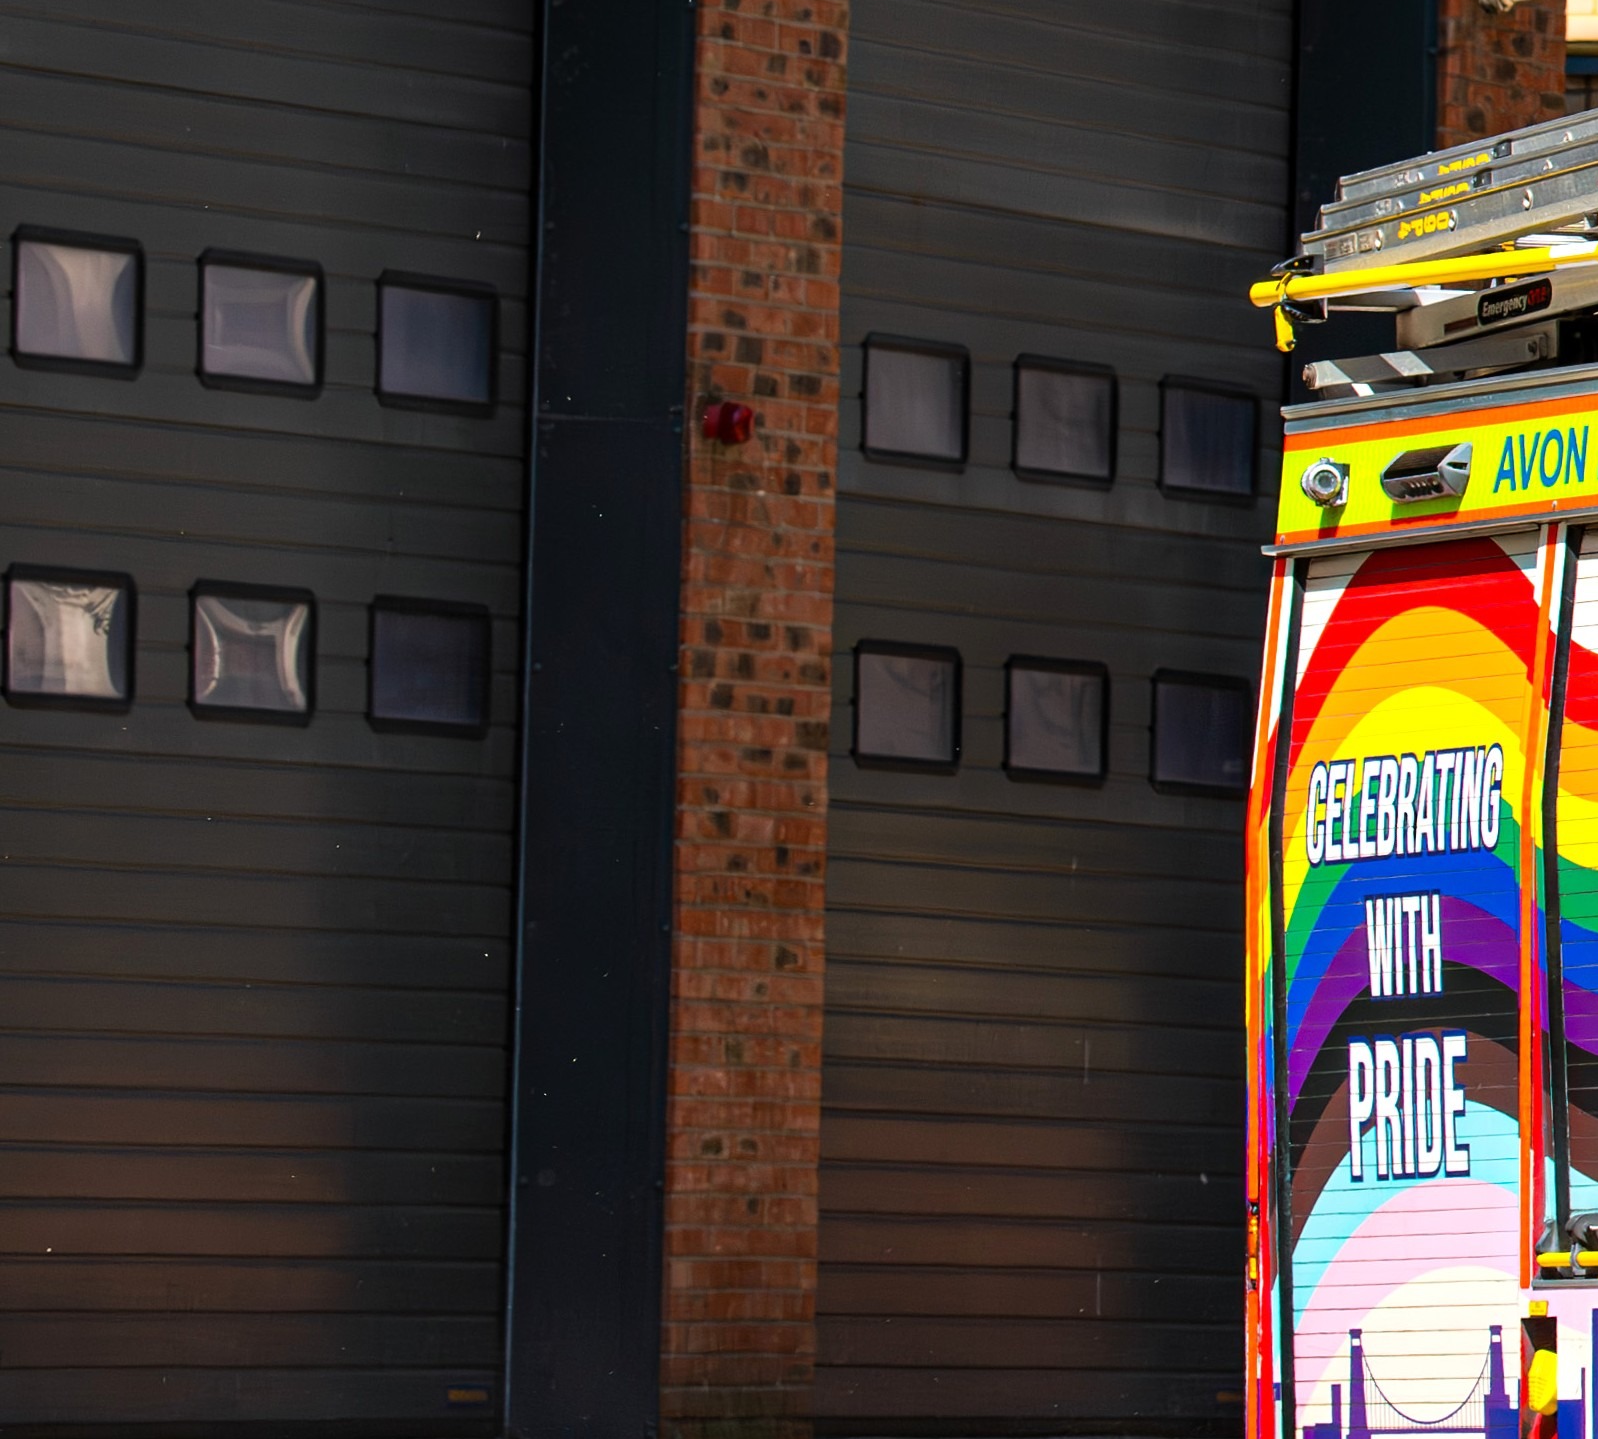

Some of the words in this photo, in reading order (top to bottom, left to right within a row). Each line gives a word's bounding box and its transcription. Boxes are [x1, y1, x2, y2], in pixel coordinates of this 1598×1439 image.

[1493, 425, 1590, 493] AVON
[1306, 743, 1503, 867] CELEBRATING
[1365, 890, 1443, 1001] WITH
[1347, 1029, 1470, 1182] PRIDE
